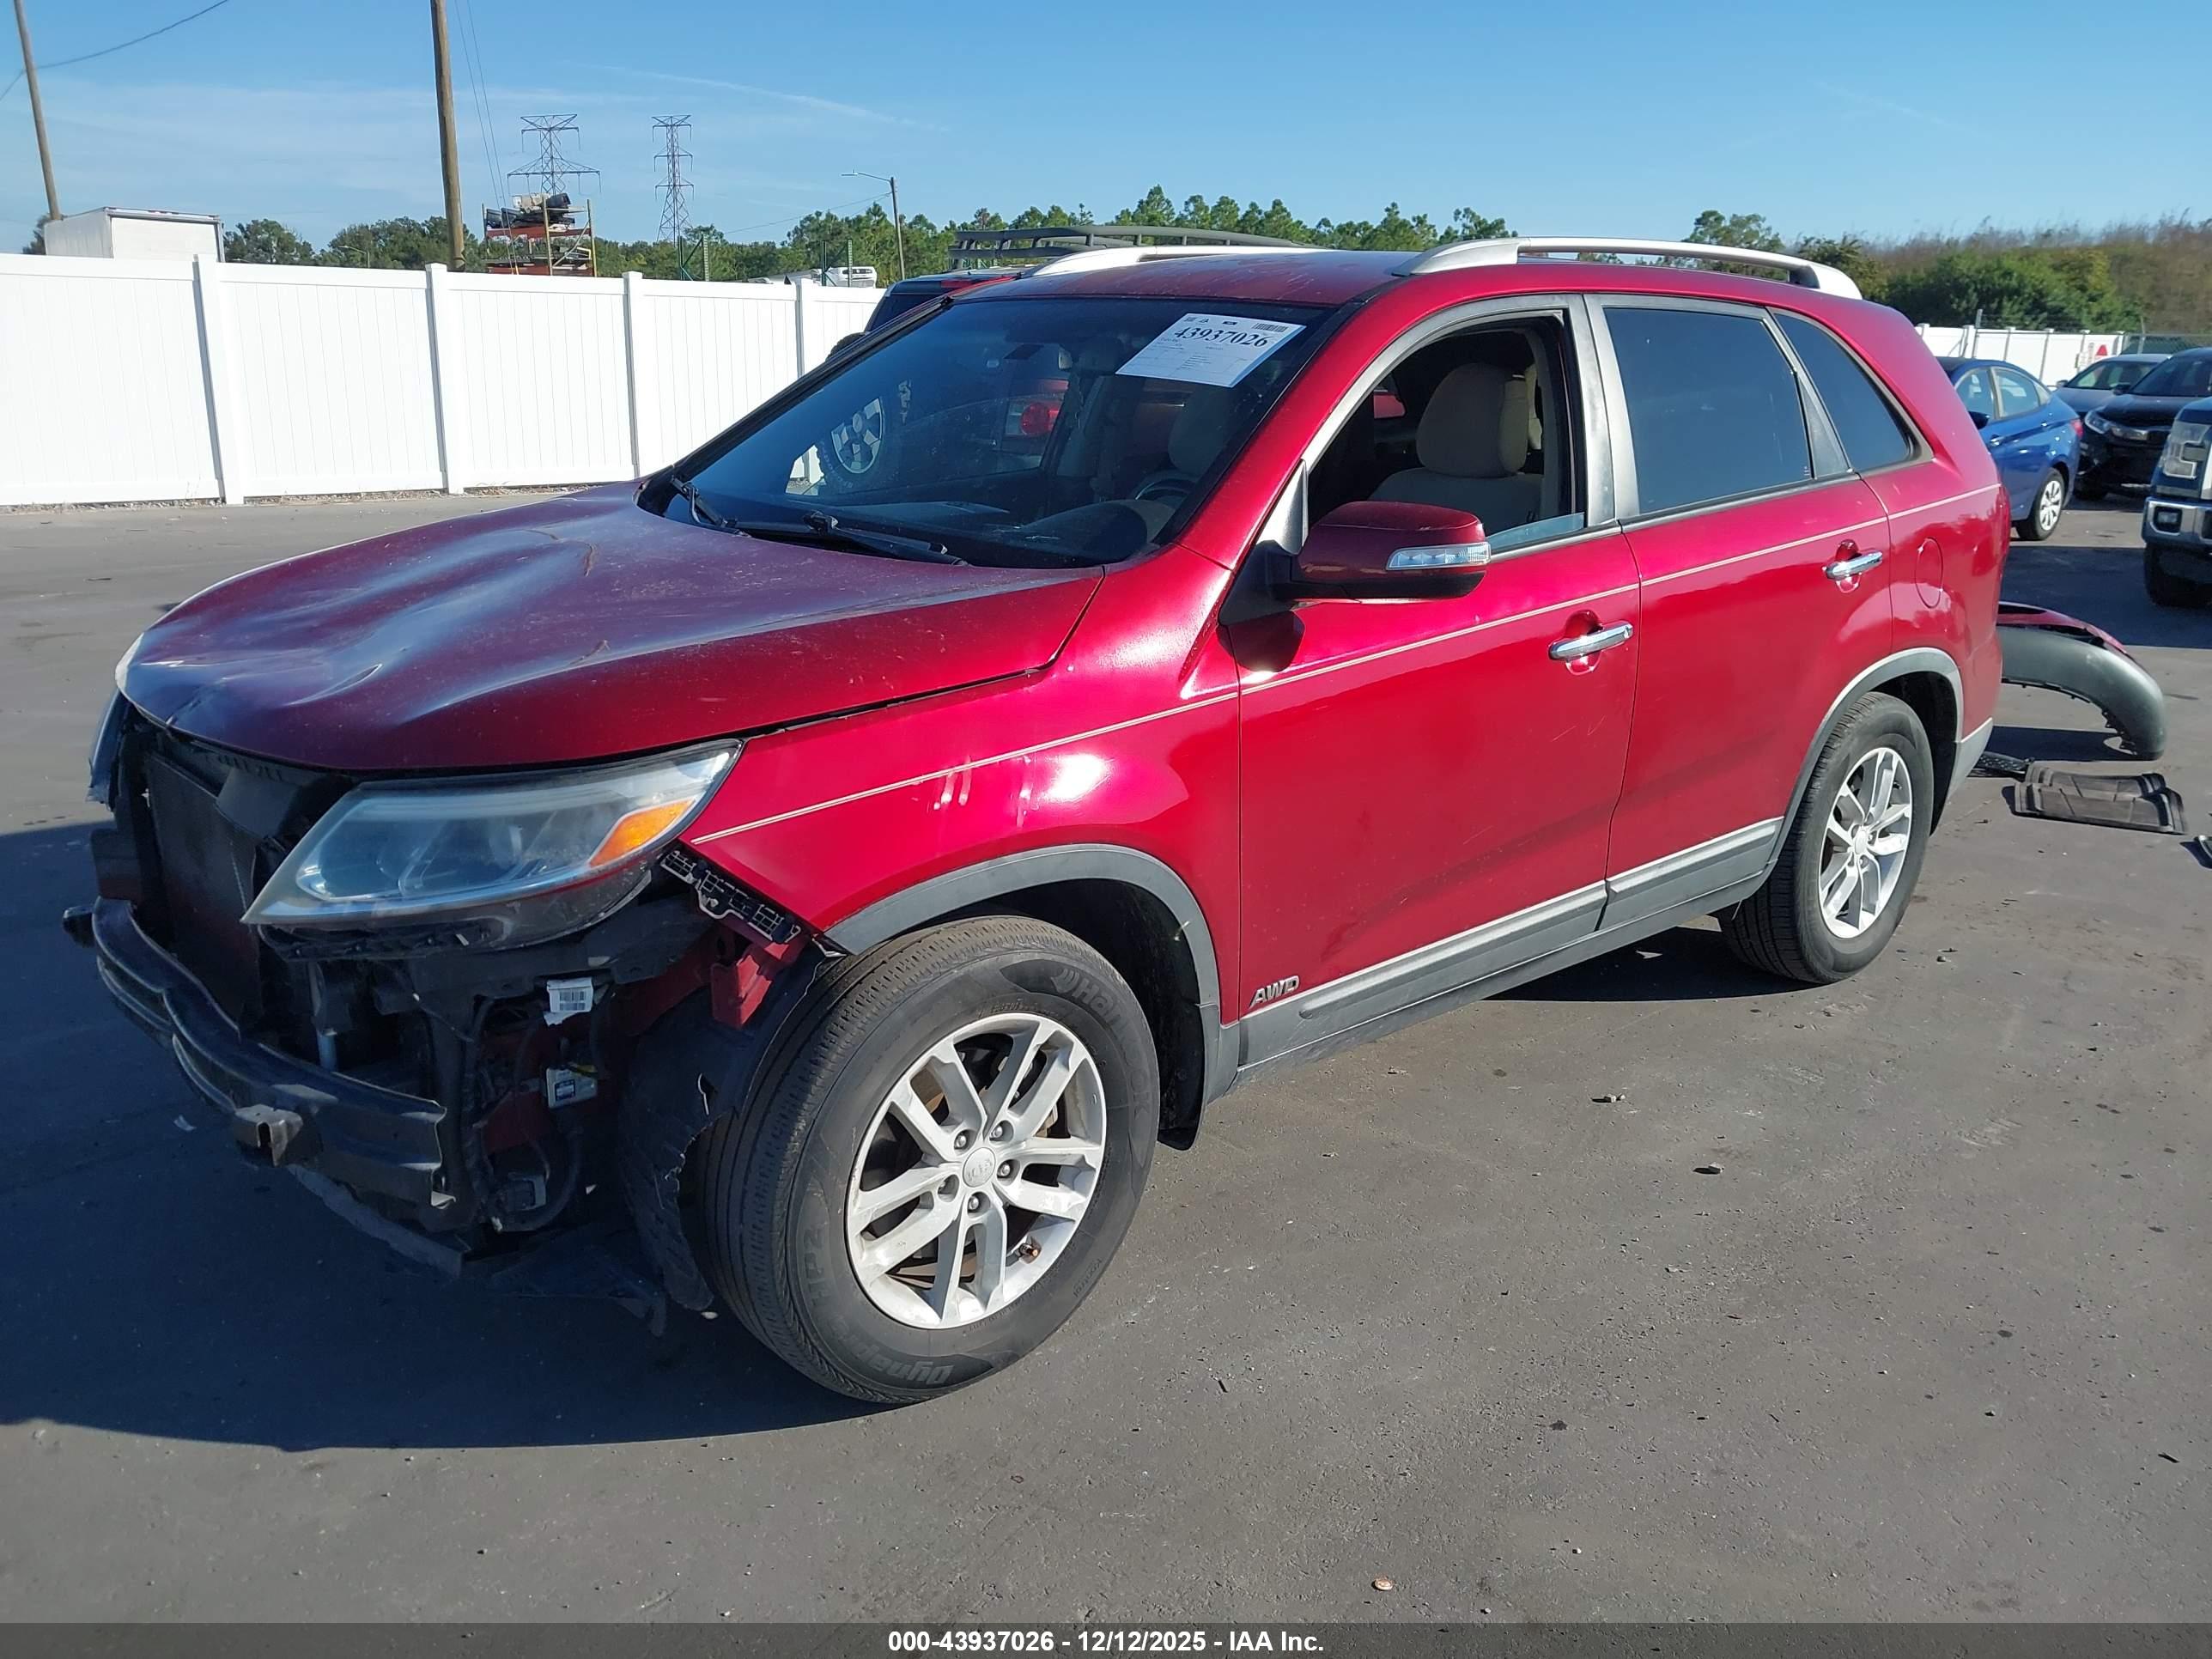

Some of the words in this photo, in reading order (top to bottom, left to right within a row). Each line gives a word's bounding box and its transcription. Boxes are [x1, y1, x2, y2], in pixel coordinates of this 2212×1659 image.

[1175, 326, 1273, 347] 43937026
[1249, 975, 1299, 1009] AWD
[1071, 977, 1151, 1121] Hankook
